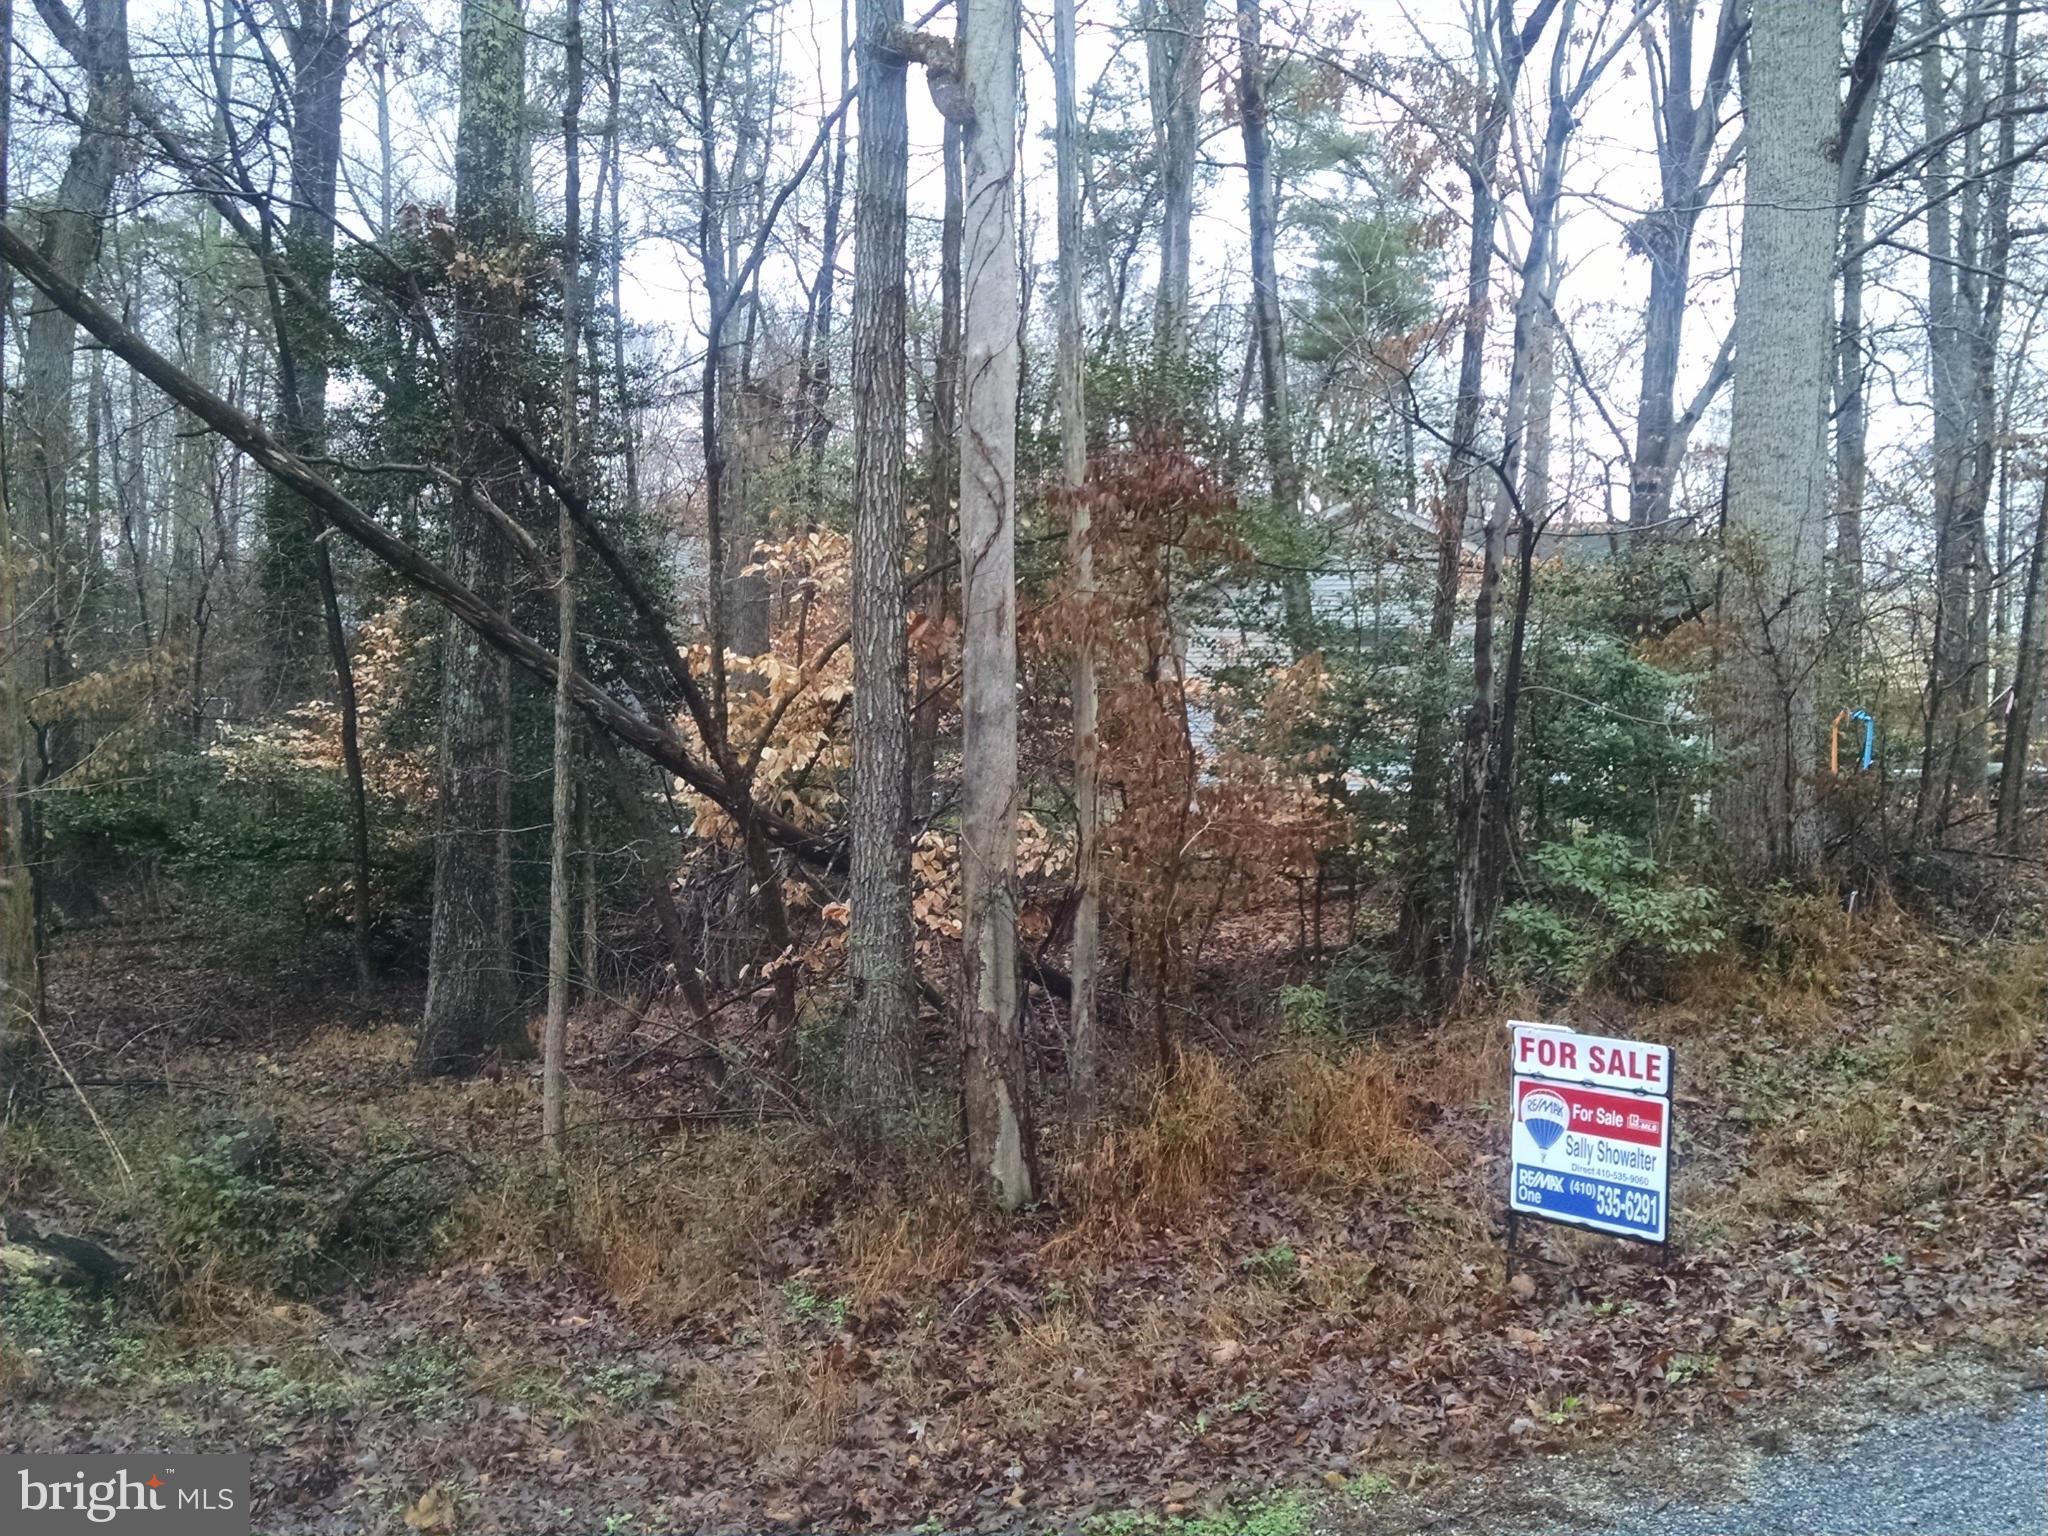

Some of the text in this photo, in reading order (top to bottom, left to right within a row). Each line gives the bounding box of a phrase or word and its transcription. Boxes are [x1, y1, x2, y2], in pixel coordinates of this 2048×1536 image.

[1520, 1037, 1661, 1082] FOR SALE
[1572, 1103, 1624, 1127] For Sale
[1565, 1134, 1657, 1172] Sally Showalter
[1519, 1169, 1565, 1193] RE/MAX
[1571, 1163, 1595, 1176] Direct
[1518, 1186, 1542, 1204] One
[1569, 1179, 1657, 1226] (410) 535-6291
